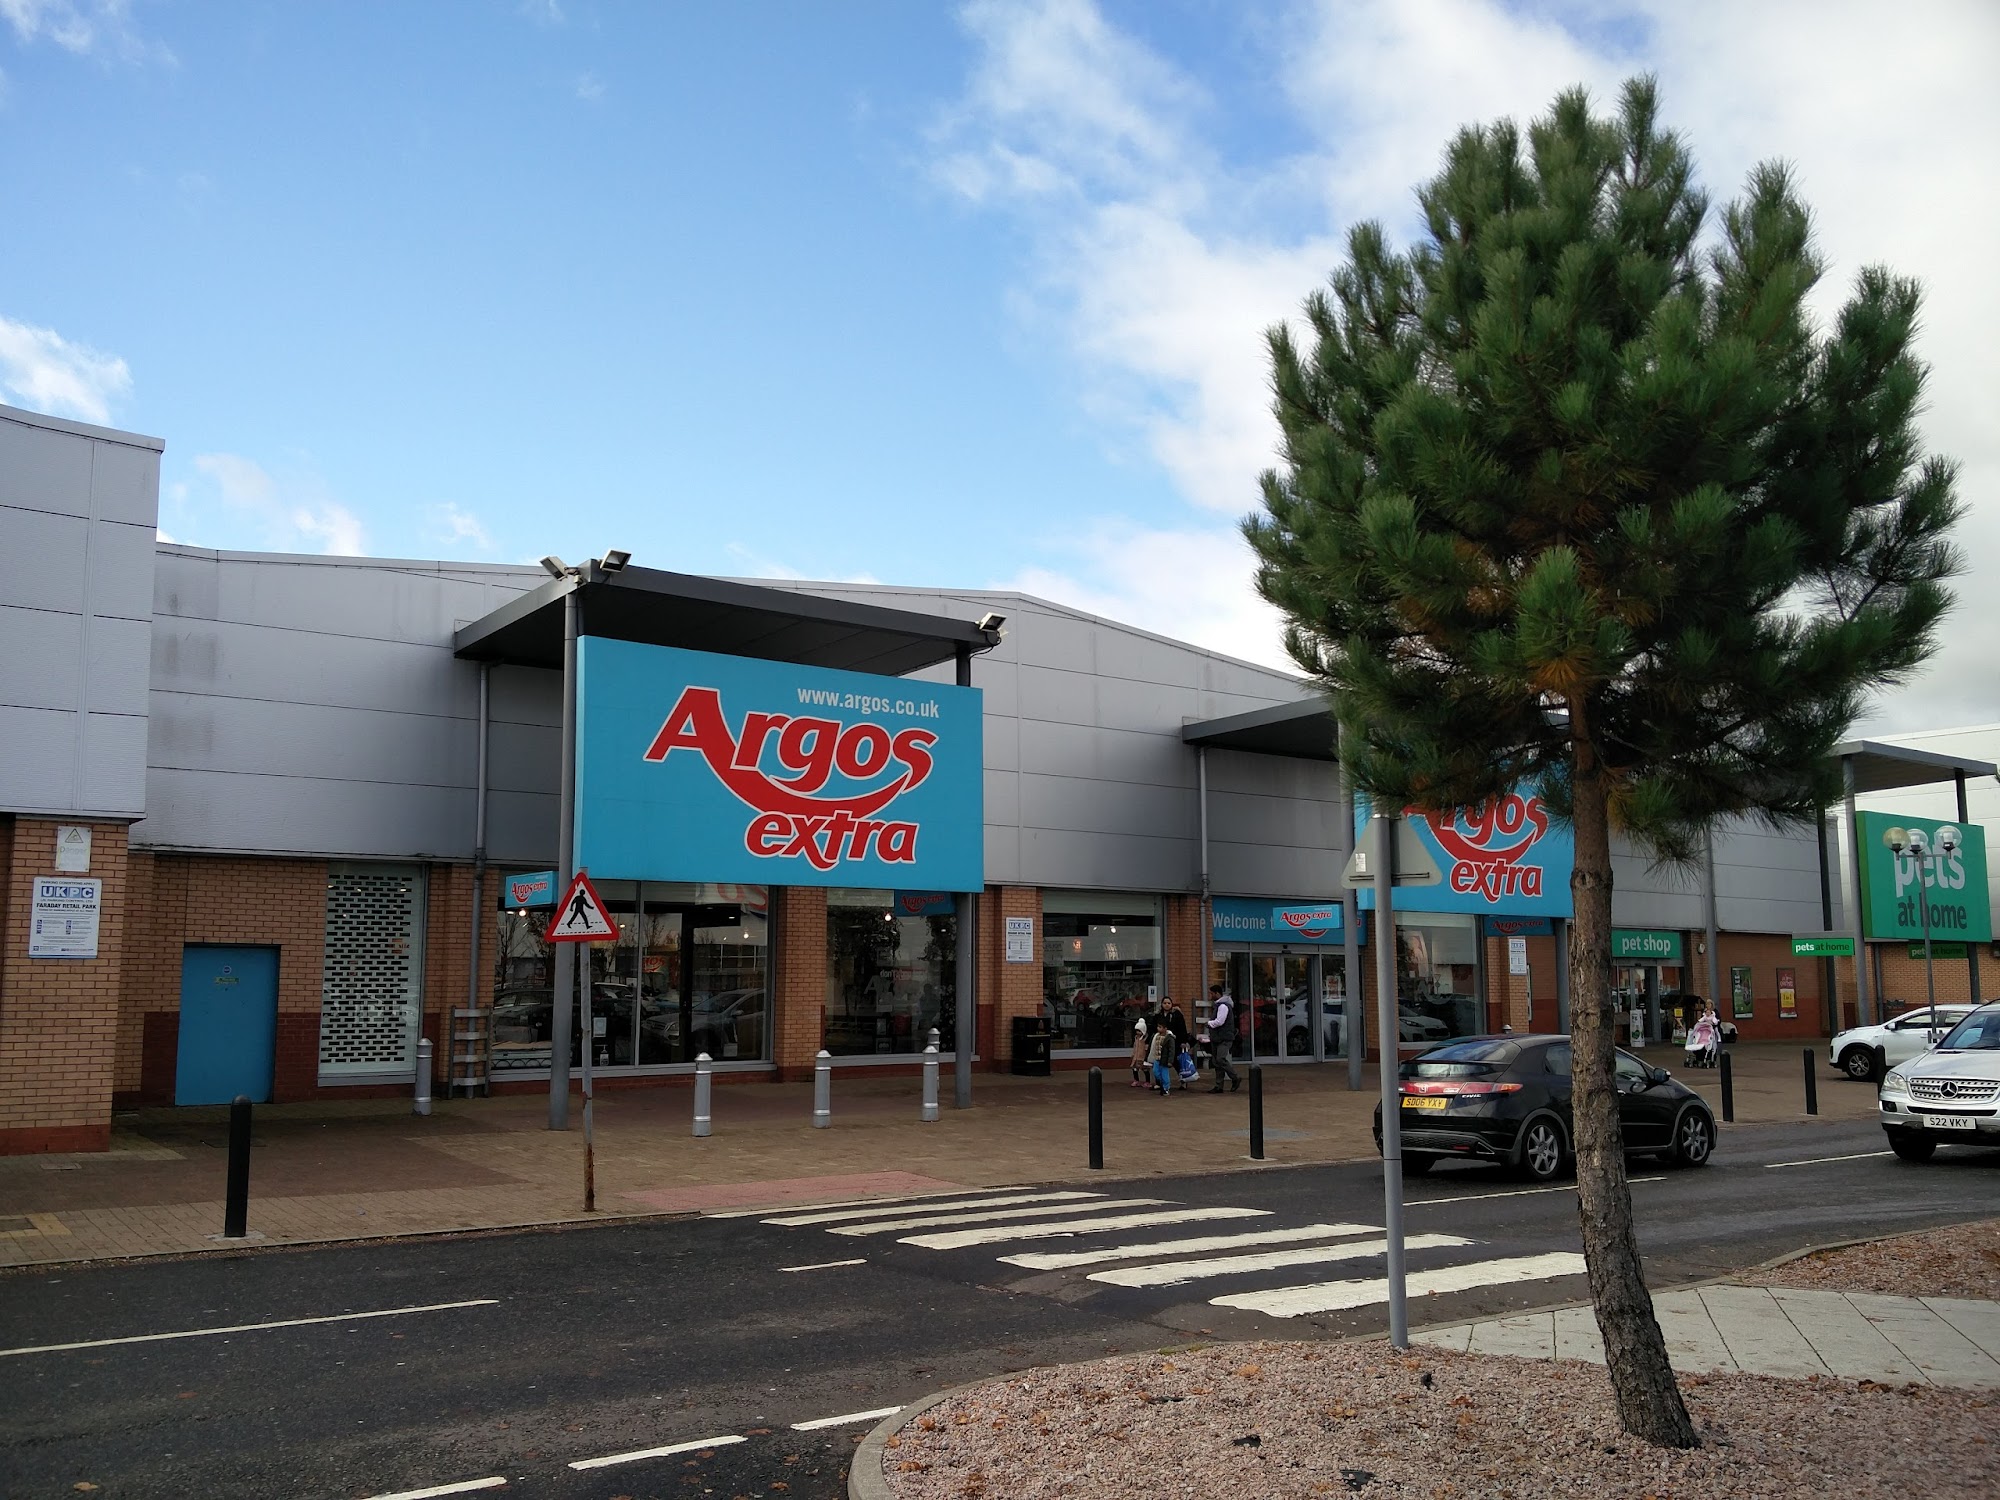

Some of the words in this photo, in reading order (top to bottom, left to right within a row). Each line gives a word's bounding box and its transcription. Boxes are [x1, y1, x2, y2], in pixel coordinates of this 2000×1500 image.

[797, 688, 939, 718] www.argos.co.uk
[643, 685, 939, 819] Argos
[745, 810, 919, 871] extra
[1450, 858, 1543, 903] extra
[41, 886, 94, 898] UKPC
[511, 881, 533, 904] Argos
[902, 895, 926, 912] Argos
[1898, 895, 1915, 927] at
[1212, 912, 1266, 929] Welcome
[1280, 911, 1311, 928] Argos
[1312, 911, 1332, 920] extra
[1492, 920, 1523, 934] Argos
[1622, 936, 1641, 954] pet
[1644, 934, 1671, 955] shop
[1795, 943, 1815, 953] pets
[1826, 942, 1849, 950] home
[1911, 947, 1926, 957] pet
[1930, 1117, 1947, 1126] S22
[1949, 1118, 1967, 1127] VKY
